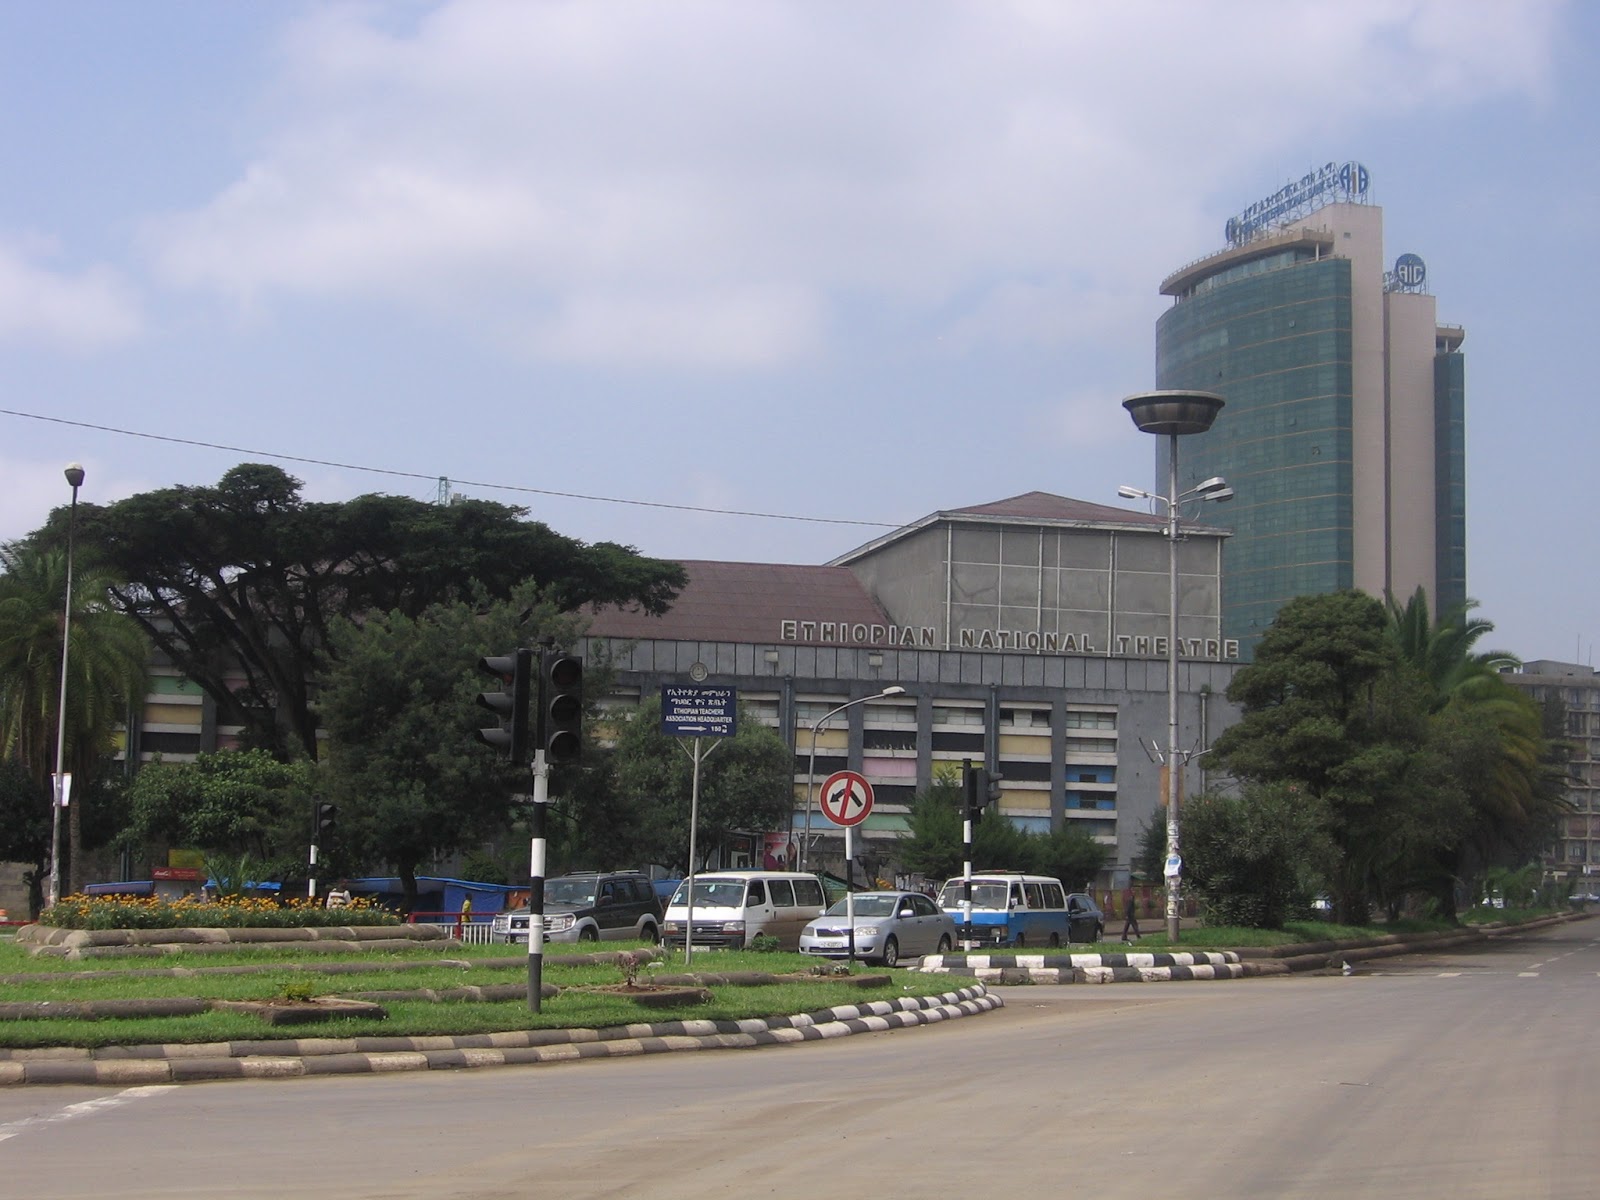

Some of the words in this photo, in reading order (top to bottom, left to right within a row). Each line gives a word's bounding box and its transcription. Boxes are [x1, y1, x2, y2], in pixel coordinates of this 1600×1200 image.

[781, 620, 936, 646] ETHIOPIAN
[960, 628, 1095, 652] NATIONAL
[1116, 634, 1239, 658] THEATRE
[673, 707, 699, 715] ETHIOPIAN
